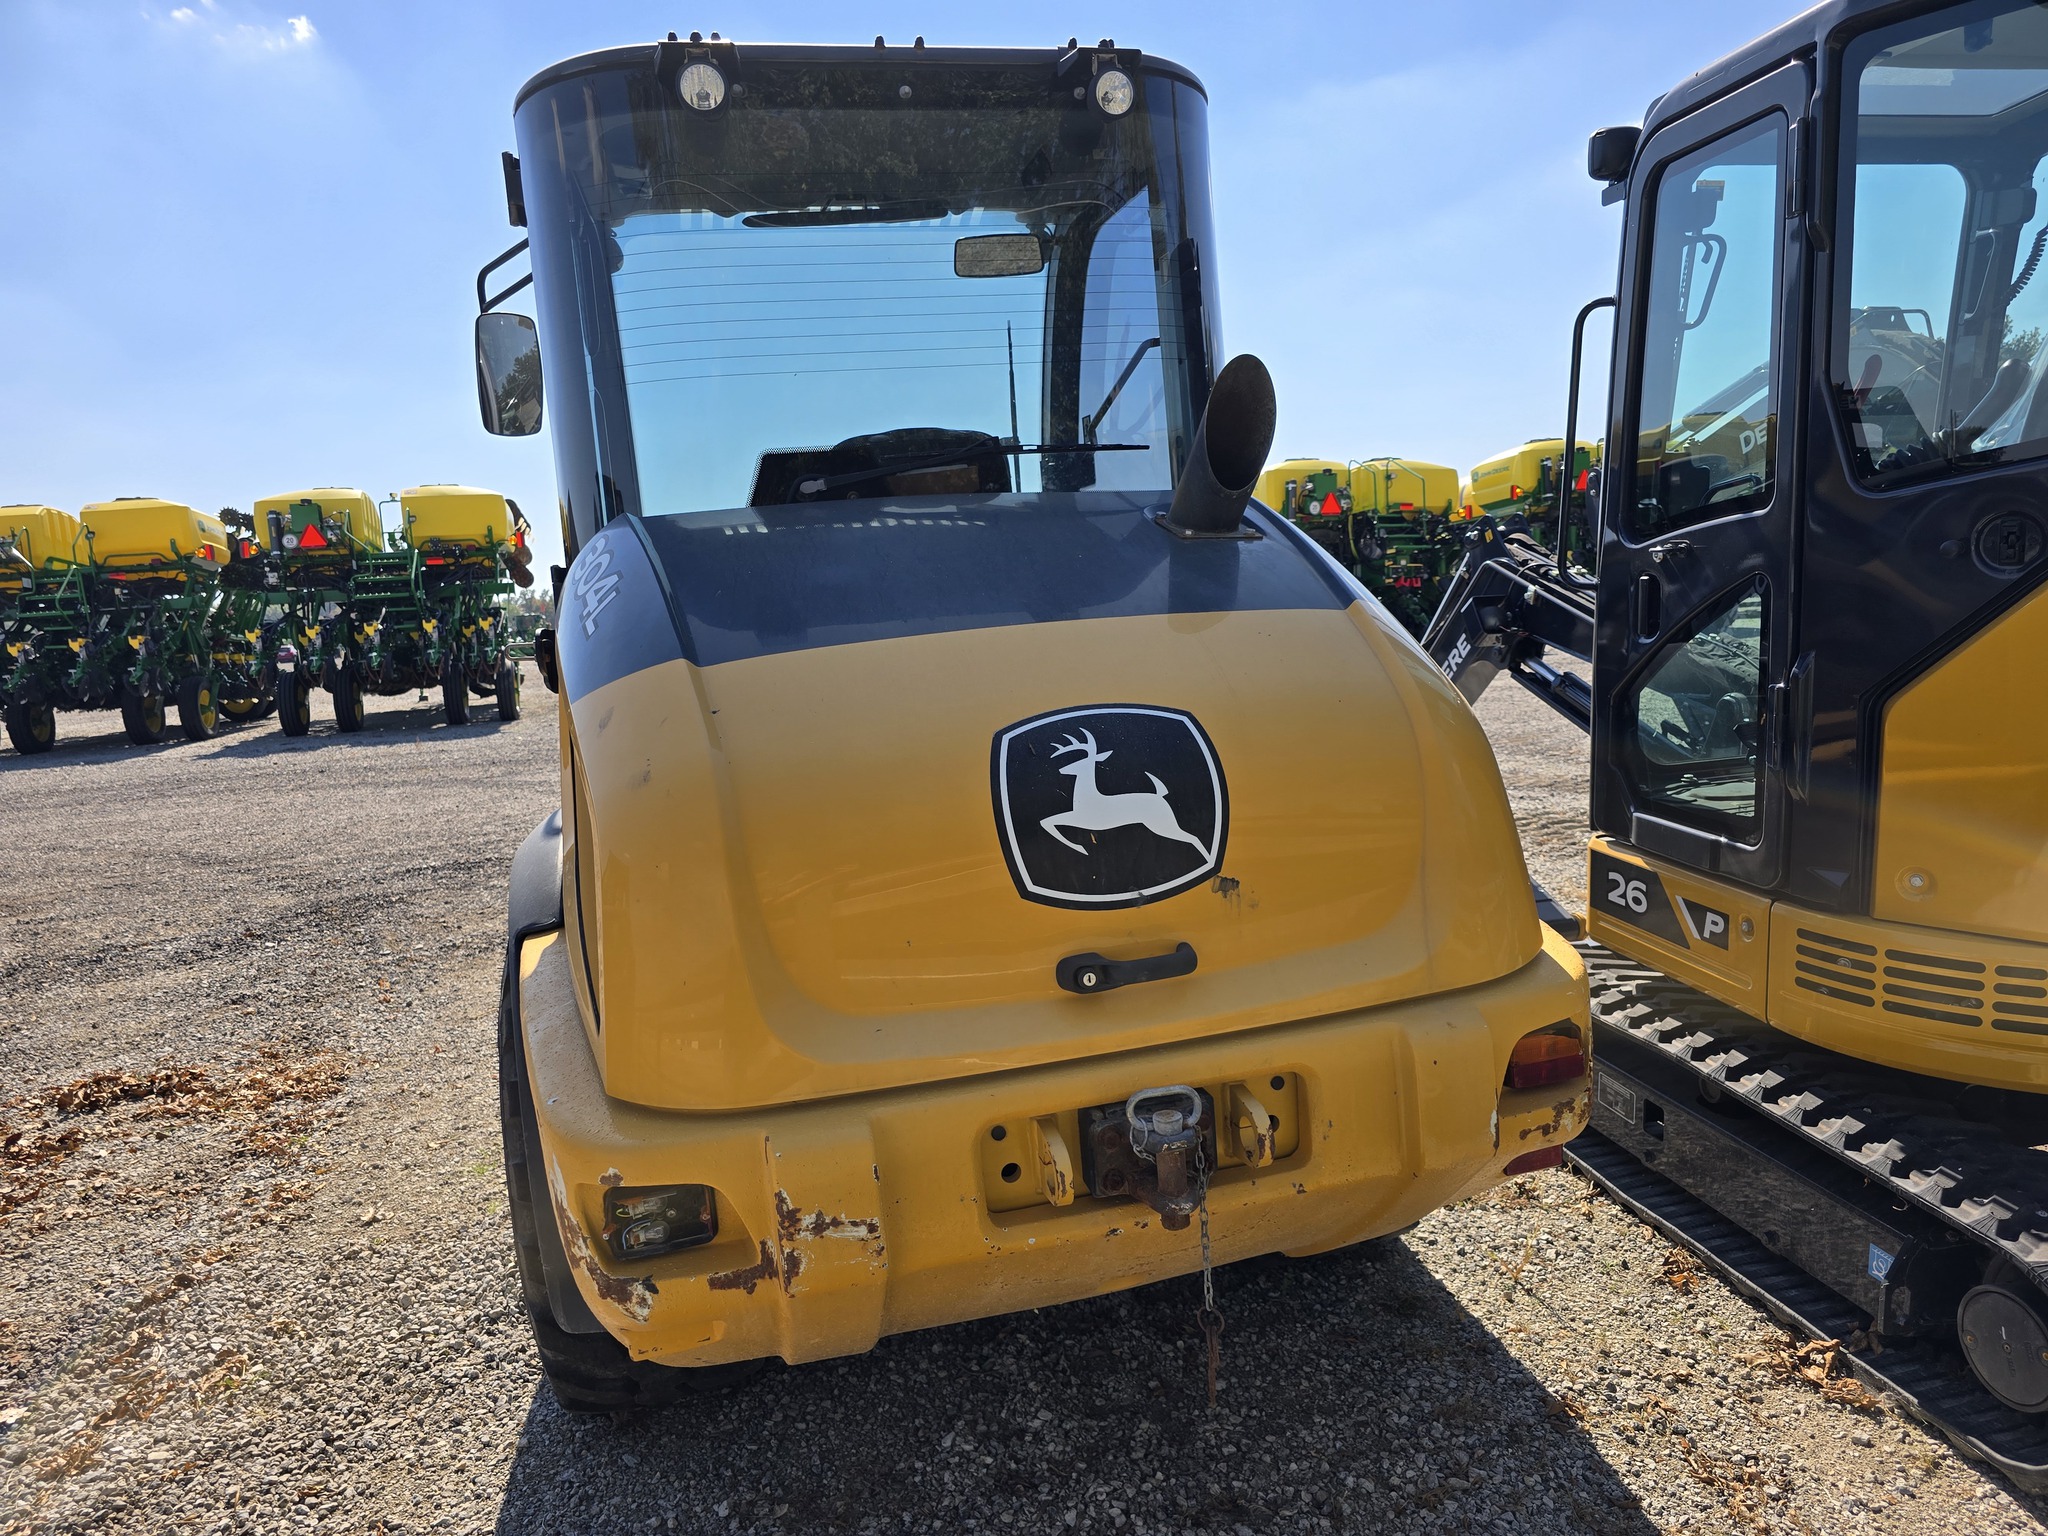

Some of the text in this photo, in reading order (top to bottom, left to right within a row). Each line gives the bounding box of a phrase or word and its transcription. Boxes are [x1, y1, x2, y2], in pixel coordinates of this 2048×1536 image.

[573, 534, 623, 641] 304L
[1607, 871, 1726, 940] 26 P
